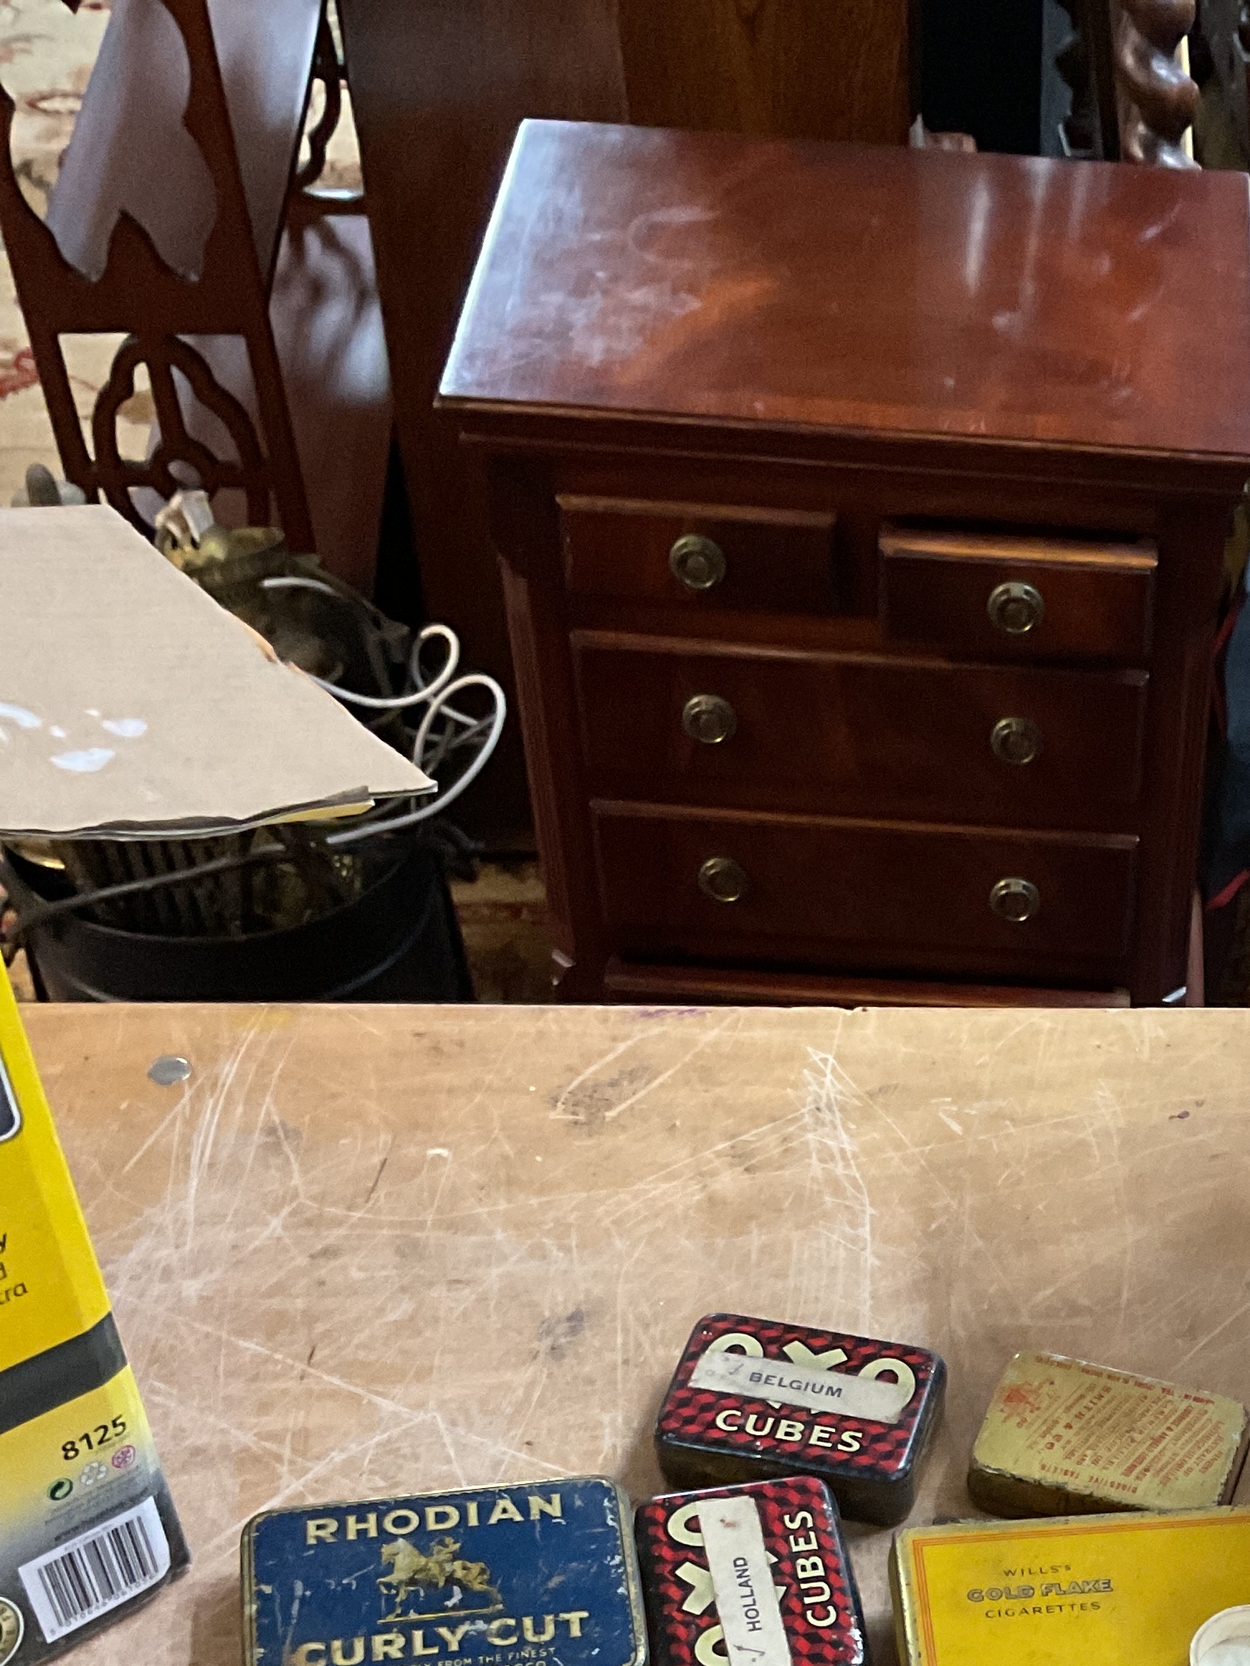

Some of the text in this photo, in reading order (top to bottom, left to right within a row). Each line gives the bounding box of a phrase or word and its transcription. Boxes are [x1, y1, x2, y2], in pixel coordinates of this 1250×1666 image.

[749, 1371, 842, 1398] BELGIUM
[61, 1414, 127, 1461] 8125
[715, 1409, 863, 1452] CUBES
[306, 1493, 562, 1545] RHODIAN
[784, 1510, 837, 1628] CUBES
[733, 1557, 763, 1632] HOLLAND
[967, 1579, 1113, 1602] GOLD FLAKE
[985, 1601, 1101, 1619] CIGARETTES
[486, 1610, 590, 1647] CUT
[478, 1652, 503, 1664] THE
[508, 1646, 555, 1660] FINEST
